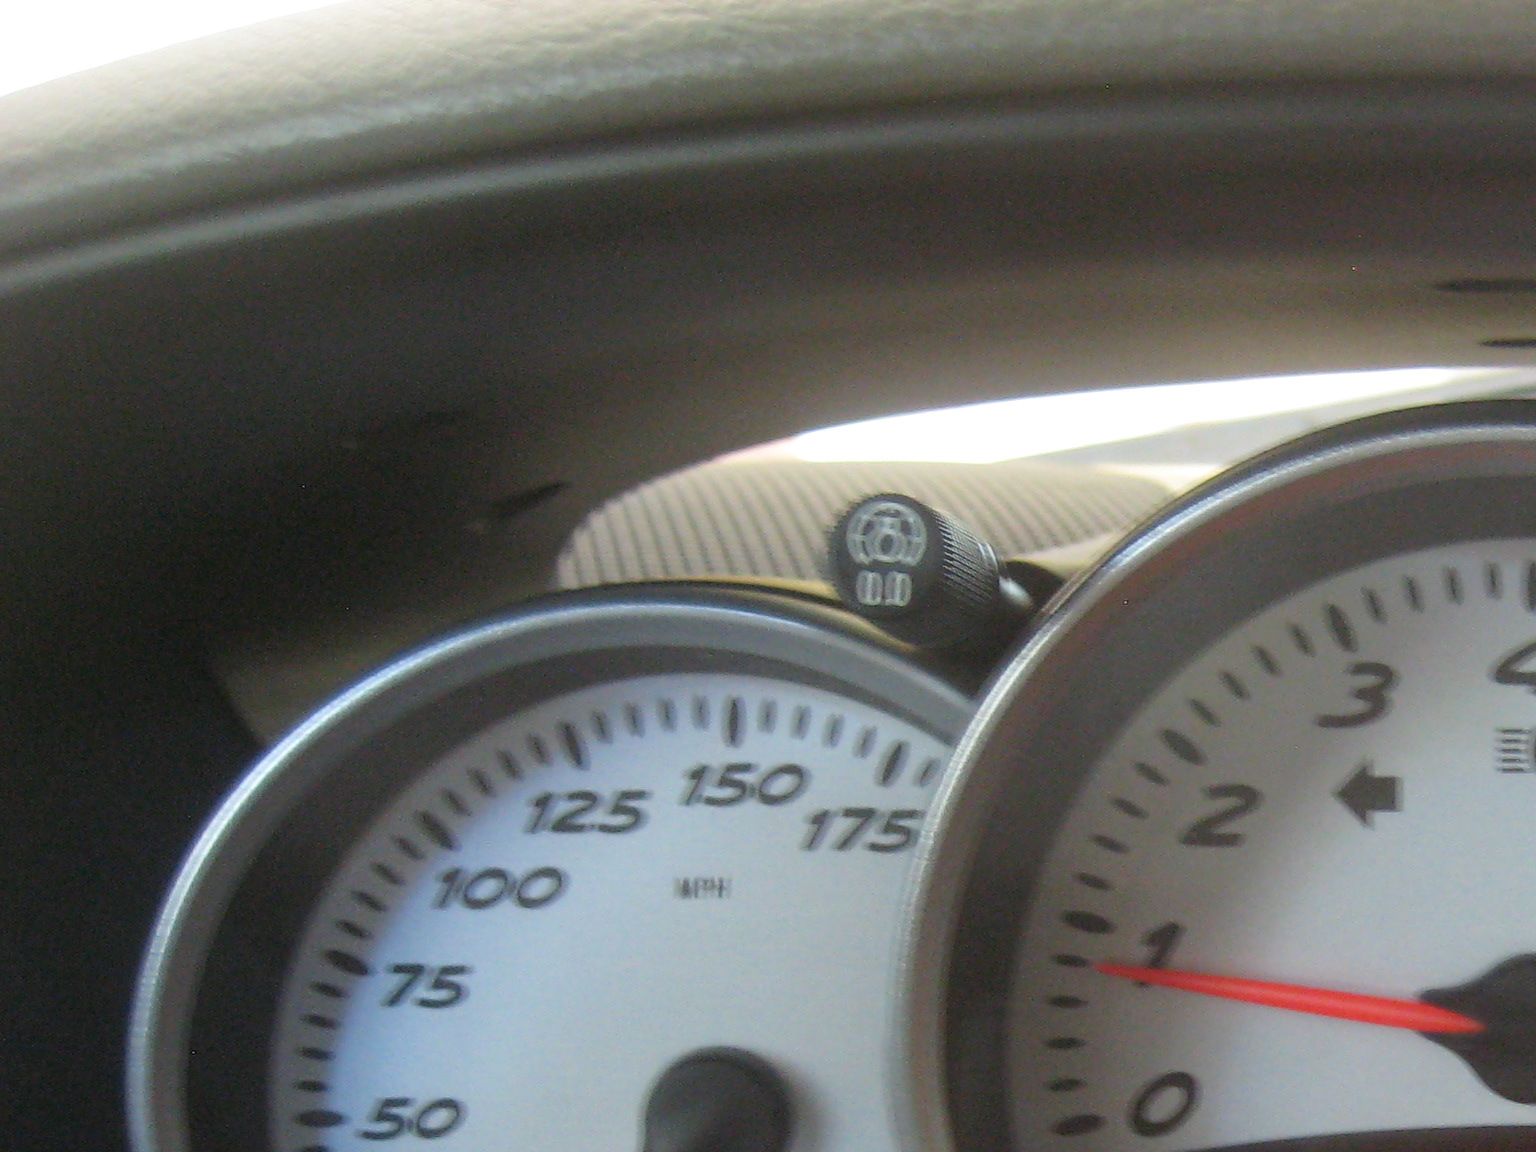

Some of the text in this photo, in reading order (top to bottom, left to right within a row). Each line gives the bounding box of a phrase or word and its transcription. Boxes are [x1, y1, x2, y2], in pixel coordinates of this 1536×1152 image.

[1314, 662, 1397, 729] 3
[683, 763, 810, 807] 150
[524, 789, 651, 834] 125
[803, 807, 921, 854] 175
[1178, 784, 1260, 848] 2
[433, 866, 567, 910] 100
[381, 963, 468, 1008] 75
[358, 1097, 464, 1141] 50
[1128, 1071, 1199, 1139] 0
